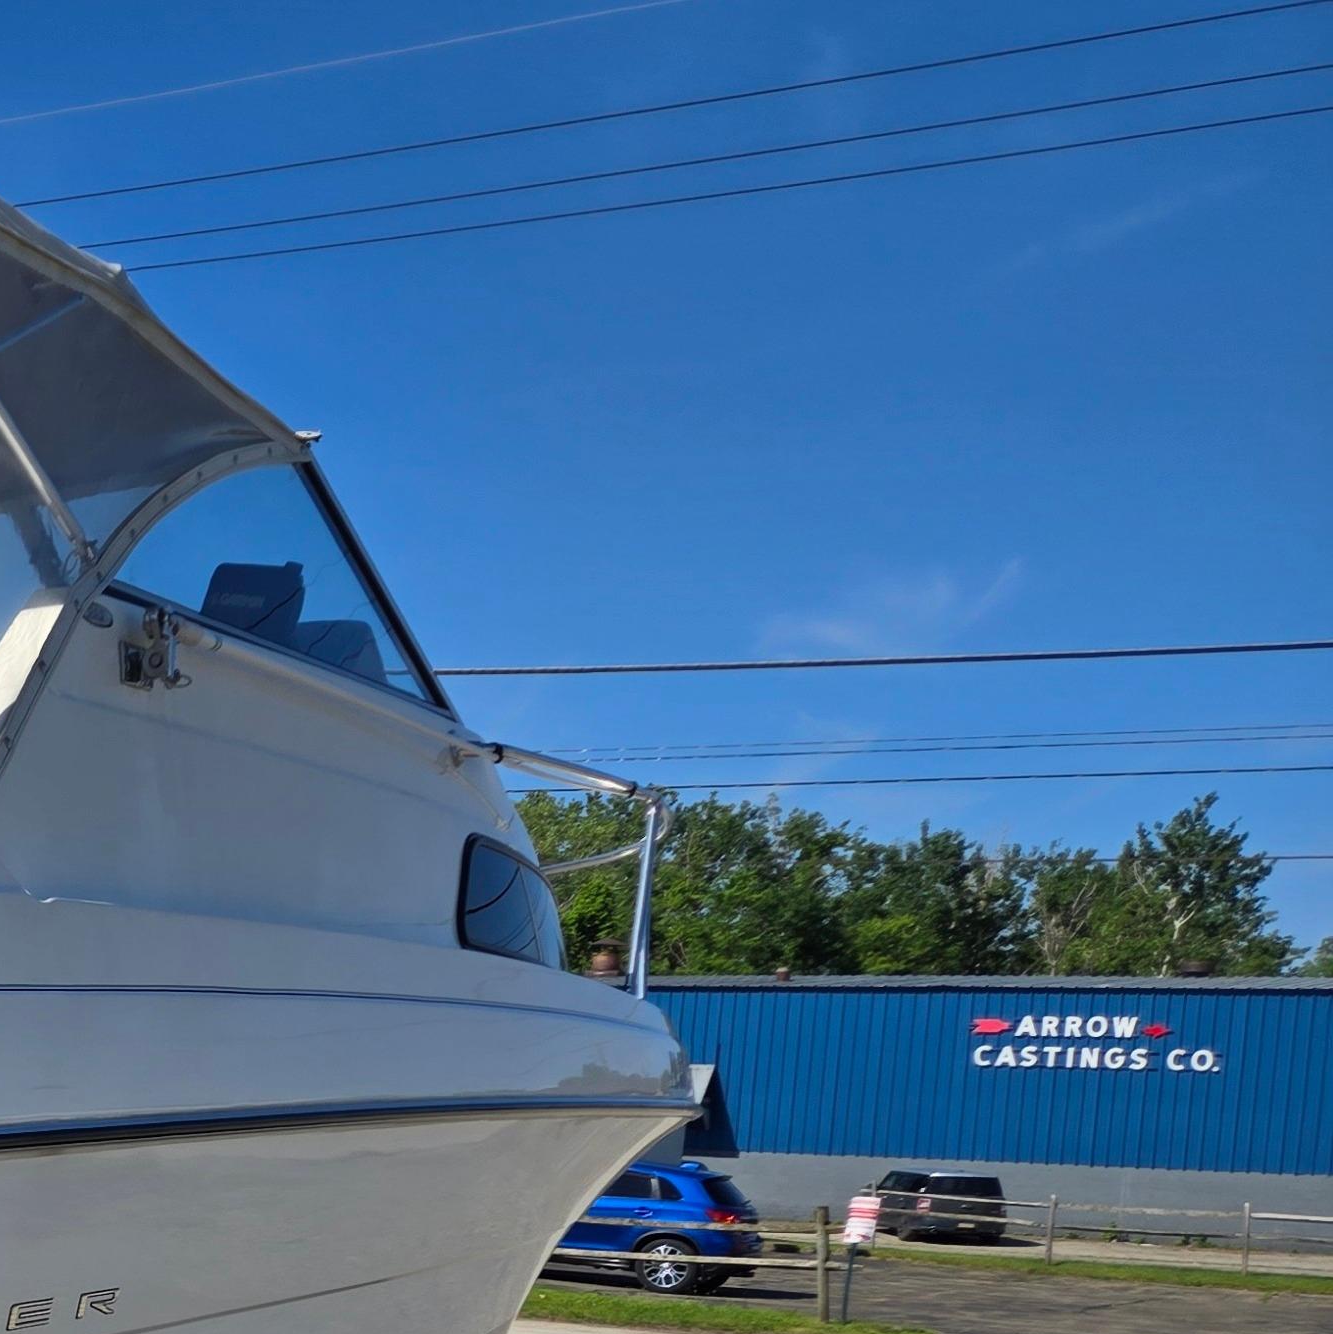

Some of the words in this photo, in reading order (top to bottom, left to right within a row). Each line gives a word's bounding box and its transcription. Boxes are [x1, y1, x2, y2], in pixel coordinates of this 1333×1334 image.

[1014, 1015, 1139, 1038] ARROW
[973, 1045, 1149, 1070] CASTINGS
[1166, 1049, 1221, 1073] CO.
